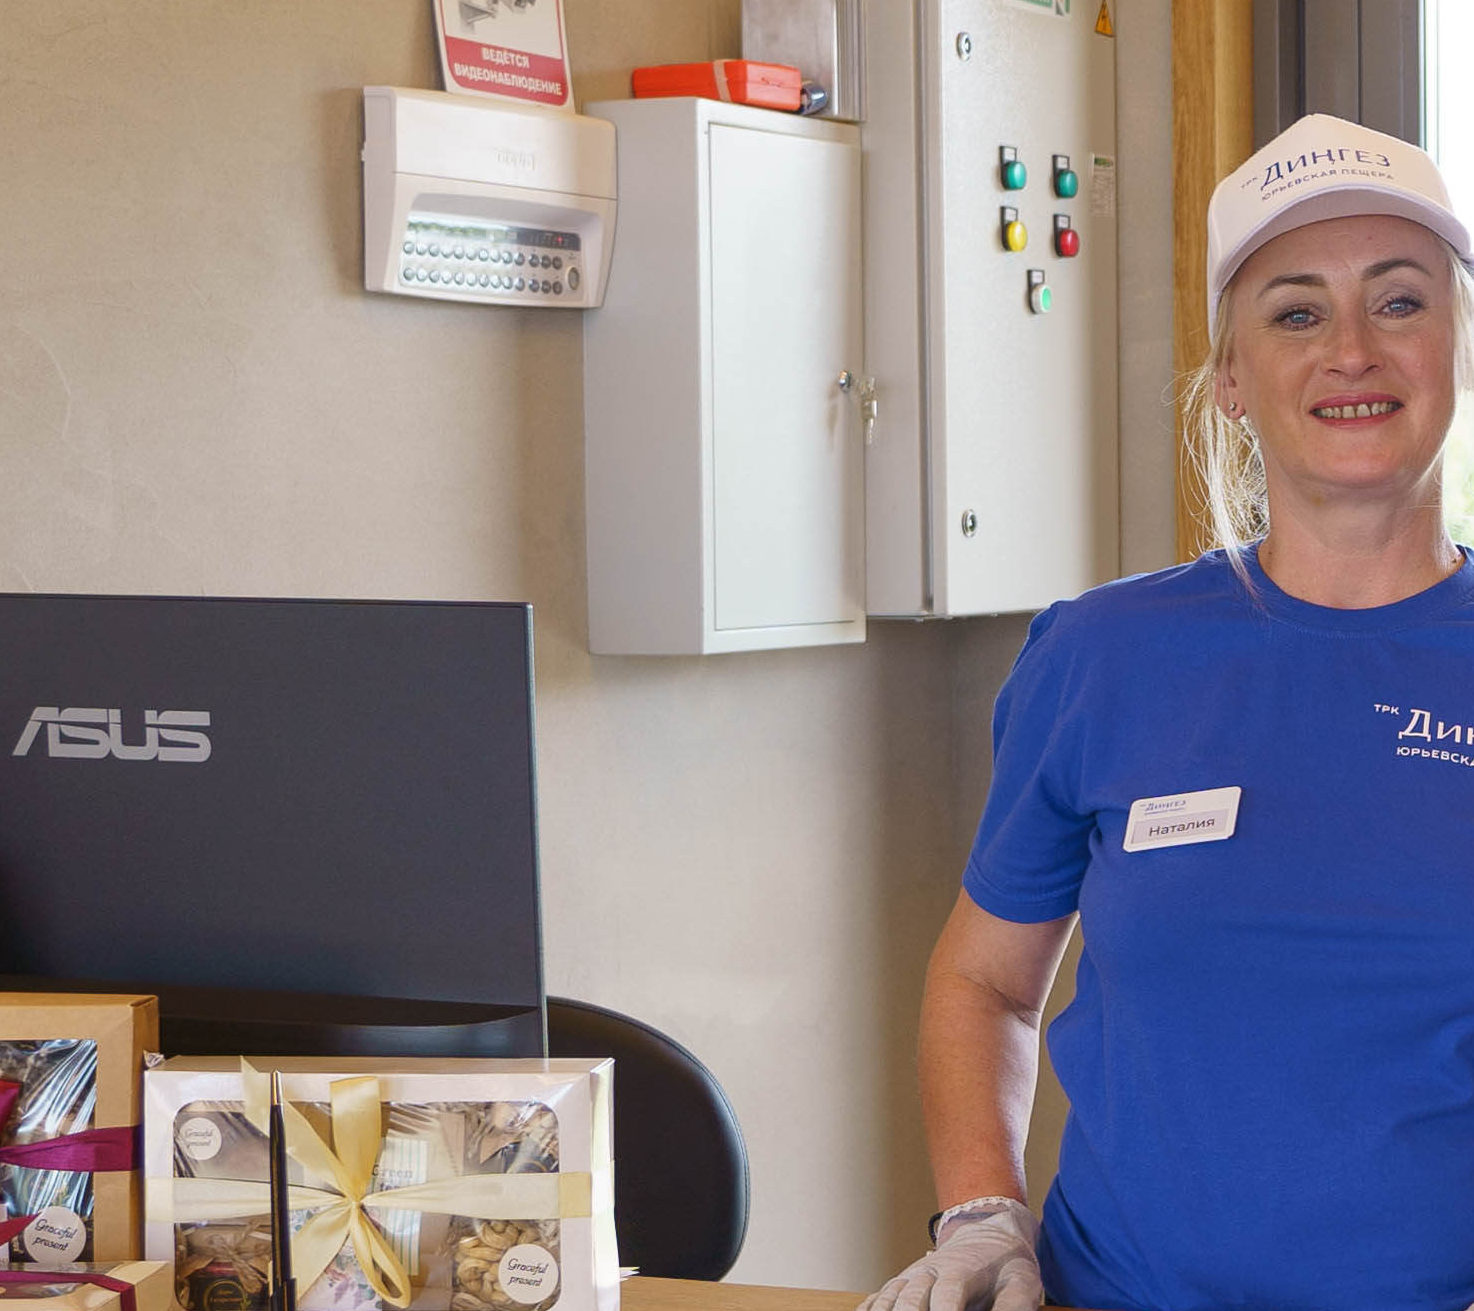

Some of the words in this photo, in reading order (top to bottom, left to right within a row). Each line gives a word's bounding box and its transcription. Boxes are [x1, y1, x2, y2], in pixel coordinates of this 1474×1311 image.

[453, 62, 563, 96] ВИДЕОНАБЛЮДЕНИЕ
[1261, 169, 1338, 202] ЮРЬЕВСКАЯ
[1341, 168, 1395, 180] ПЕЩЕРА
[1374, 703, 1400, 715] ТРК
[12, 706, 212, 763] ASUS
[1149, 818, 1216, 837] Наталия
[34, 1218, 78, 1239] Graceful
[508, 1257, 550, 1276] Graceful
